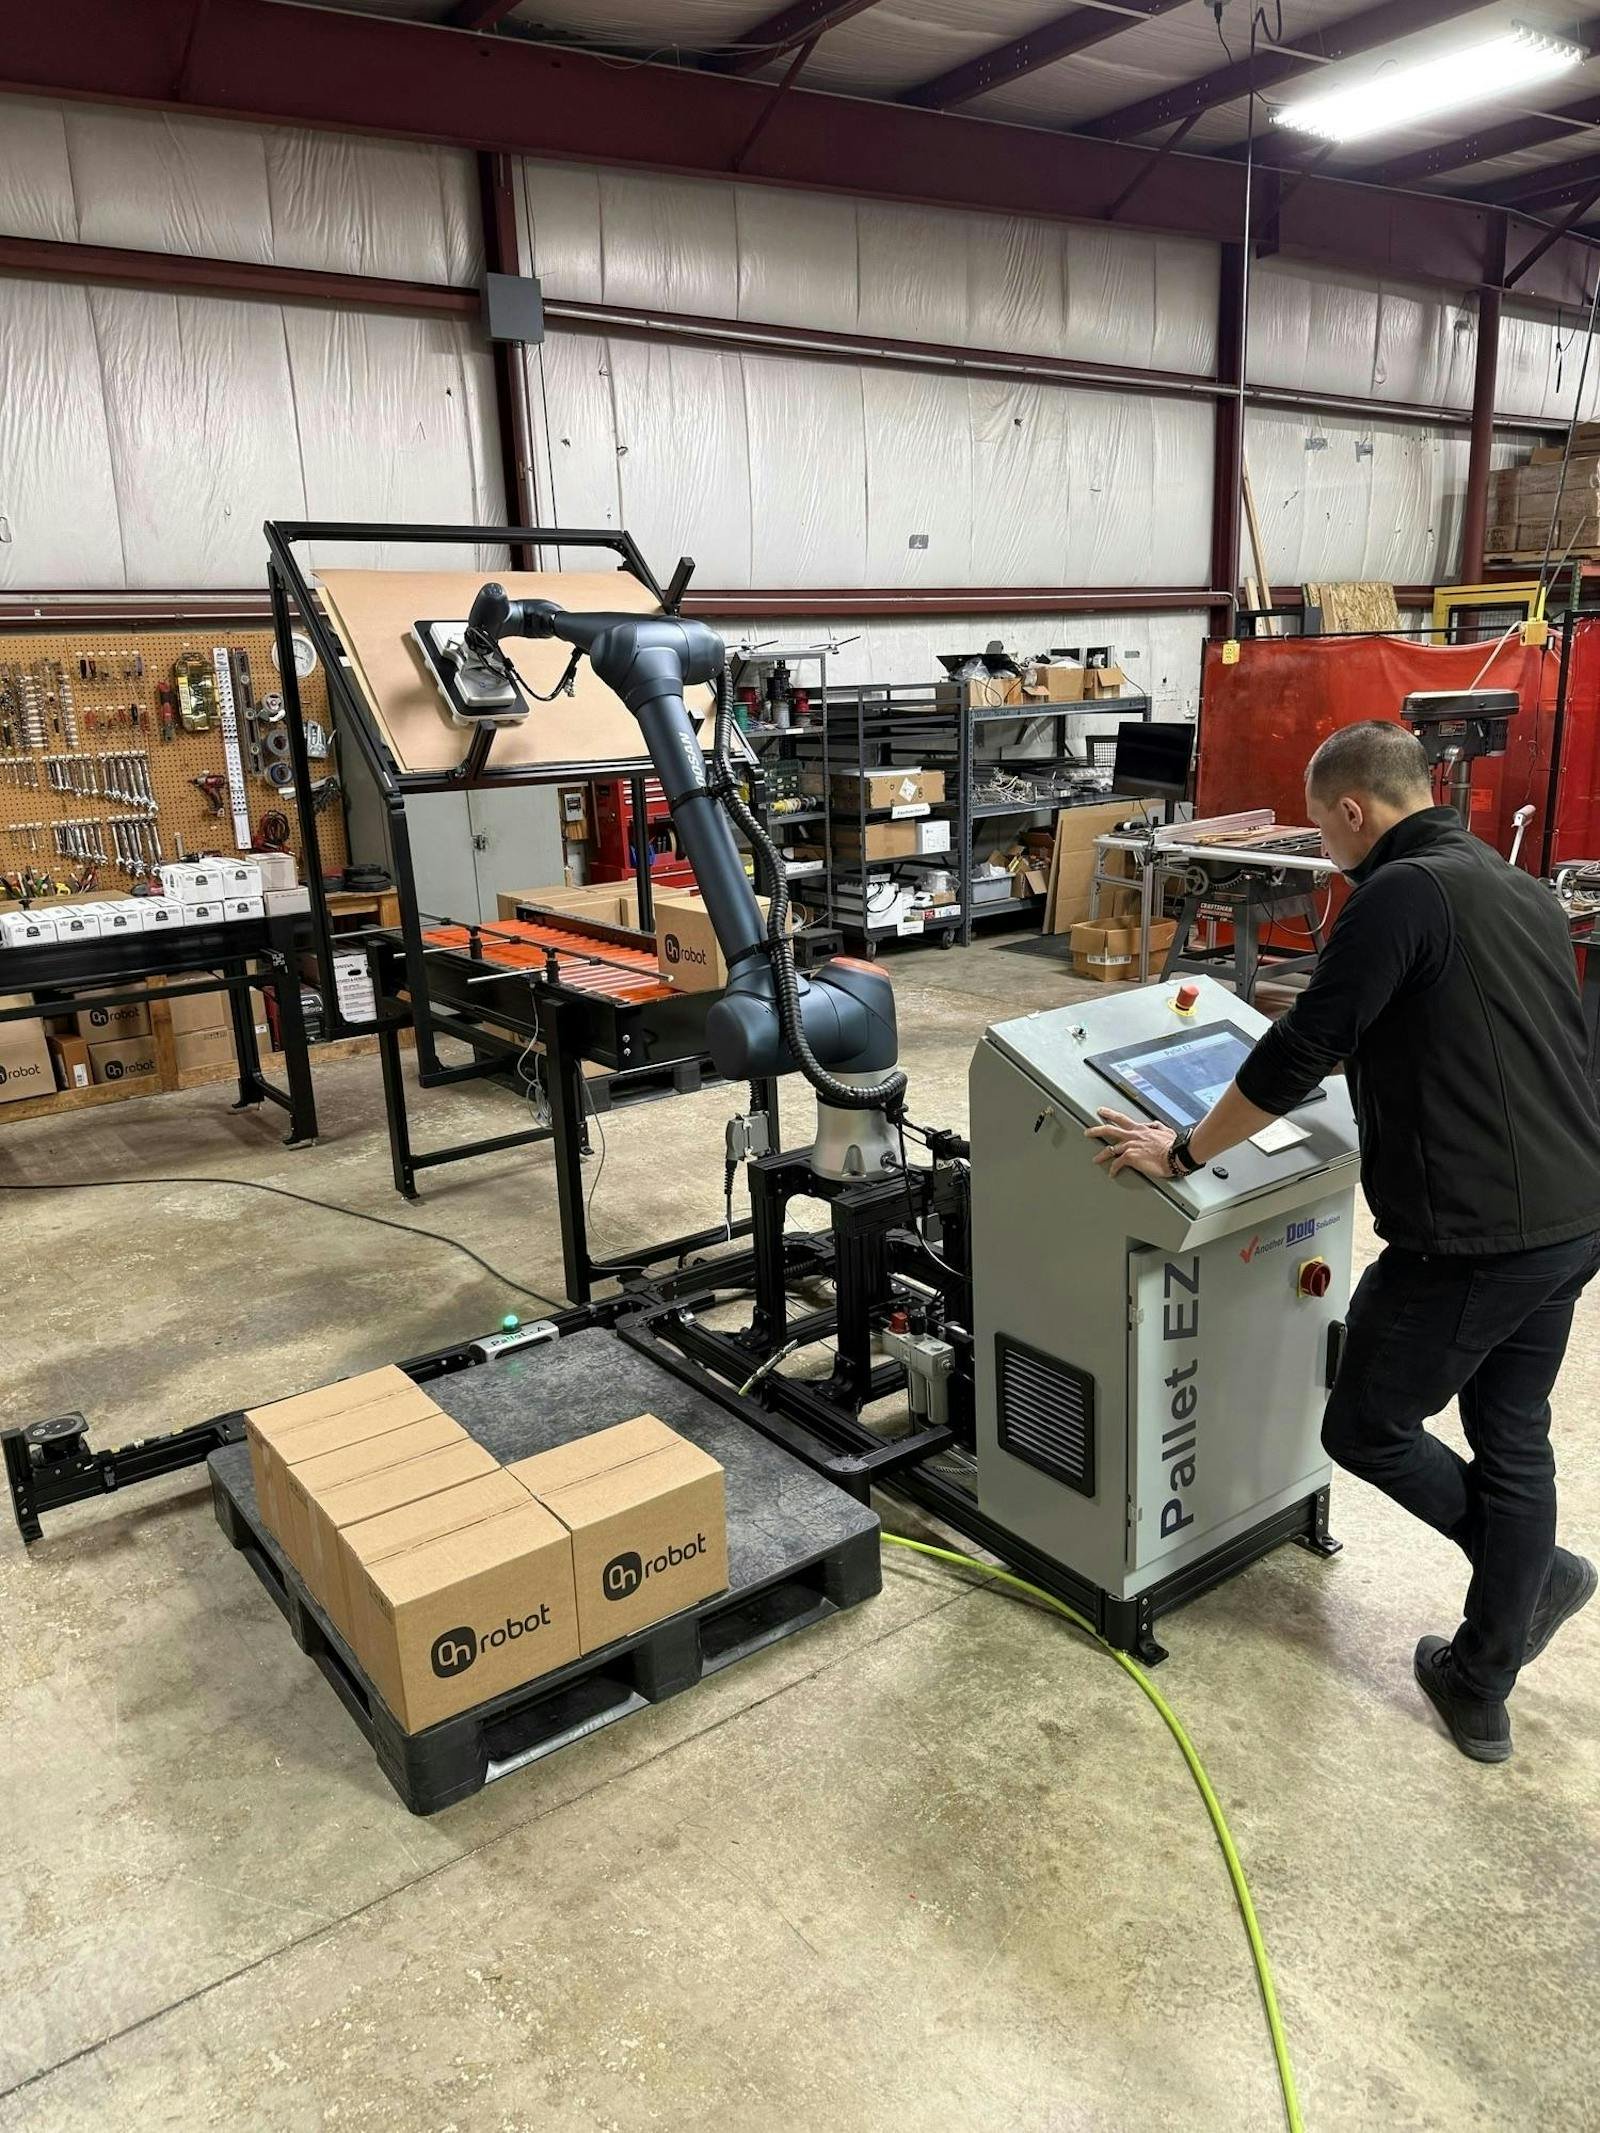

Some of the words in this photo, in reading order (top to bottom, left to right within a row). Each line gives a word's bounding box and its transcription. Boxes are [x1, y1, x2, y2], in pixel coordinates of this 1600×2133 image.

[678, 731, 707, 787] OOSAN
[680, 946, 707, 965] robot
[109, 1007, 140, 1021] robot
[8, 1064, 41, 1080] robot
[125, 1060, 155, 1073] robot
[1255, 1237, 1285, 1256] Another
[1286, 1218, 1315, 1248] Doig
[1315, 1215, 1341, 1231] Solution
[1163, 1256, 1200, 1341] EZ
[1160, 1358, 1198, 1539] Pallet
[644, 1533, 706, 1579] robot
[480, 1604, 551, 1654] robot
